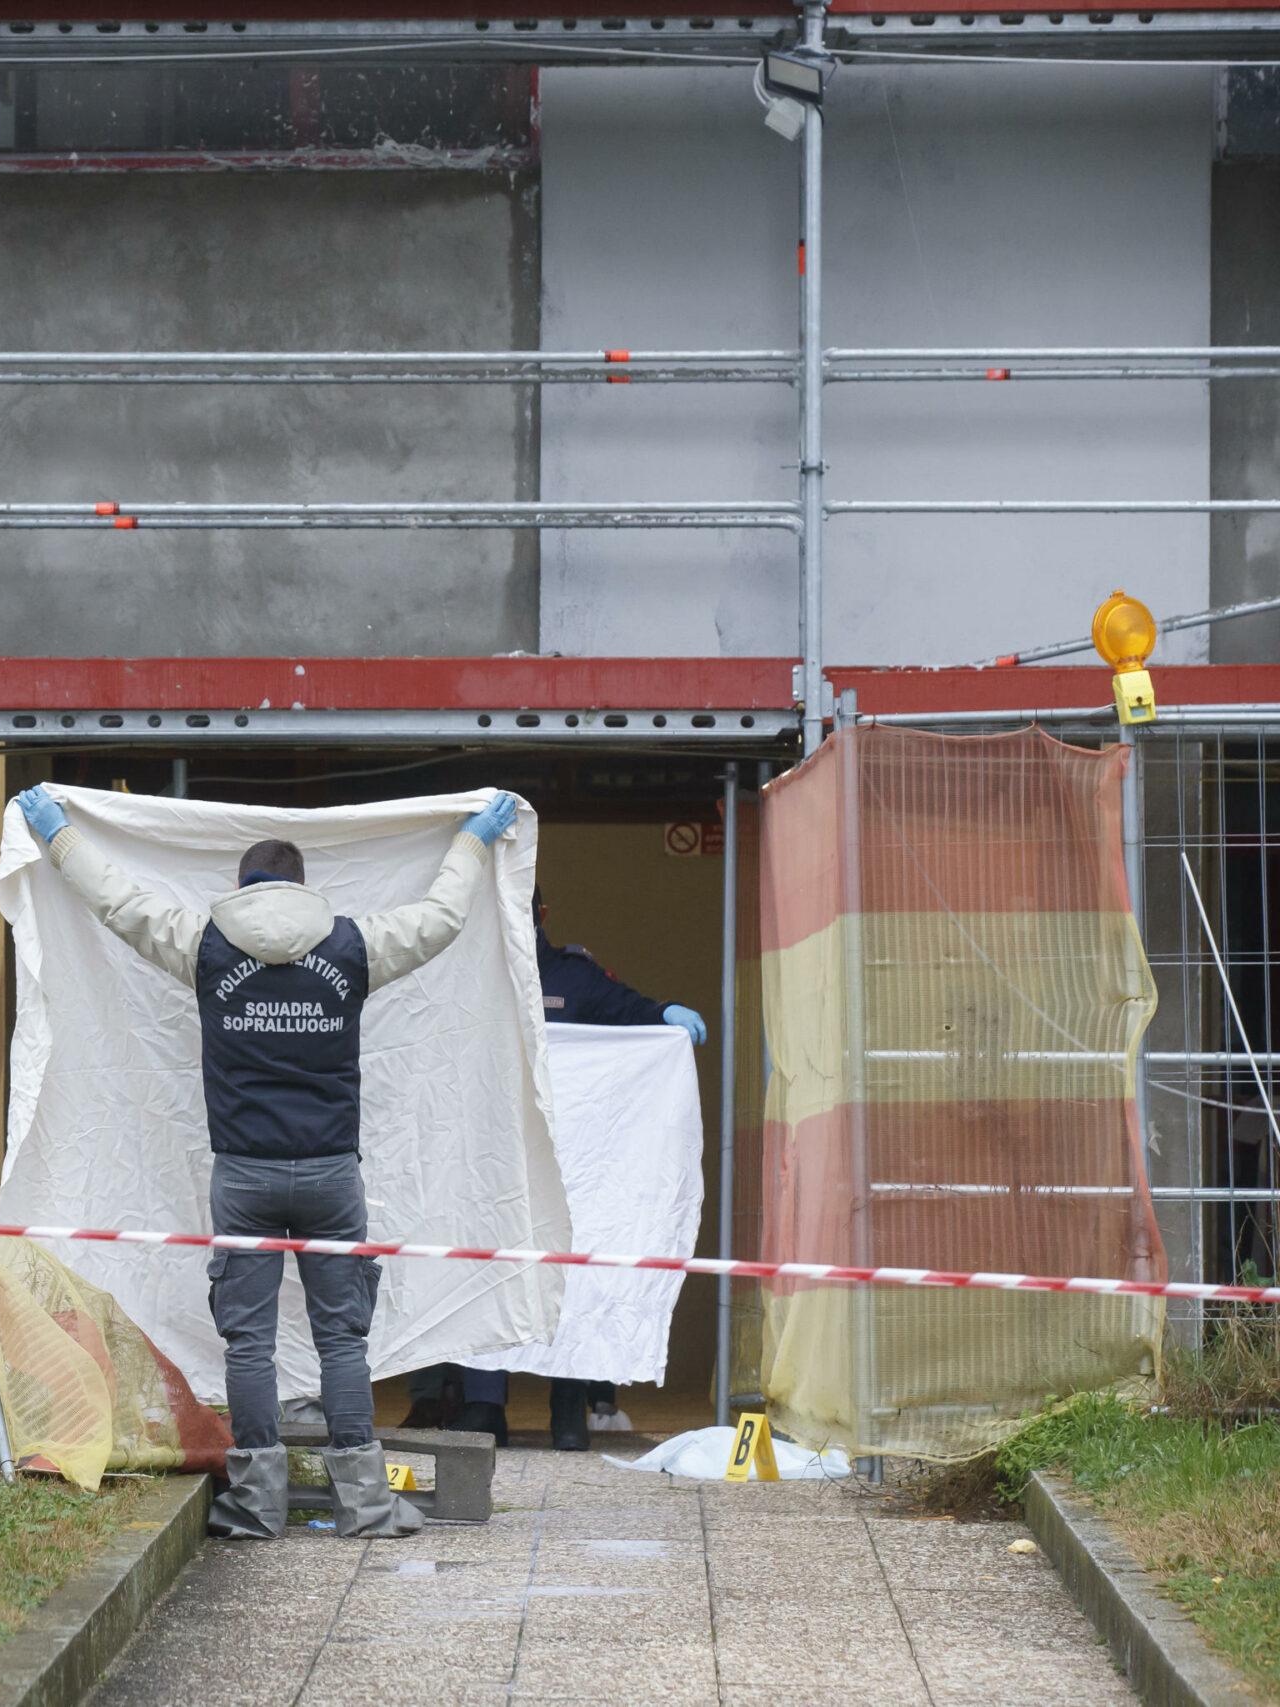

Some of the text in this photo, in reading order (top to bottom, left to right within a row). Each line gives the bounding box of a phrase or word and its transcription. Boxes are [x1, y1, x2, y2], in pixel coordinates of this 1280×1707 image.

[245, 1002, 324, 1017] SQUADRA
[223, 1016, 343, 1032] SOPRALLUOGHI
[734, 1420, 754, 1465] B
